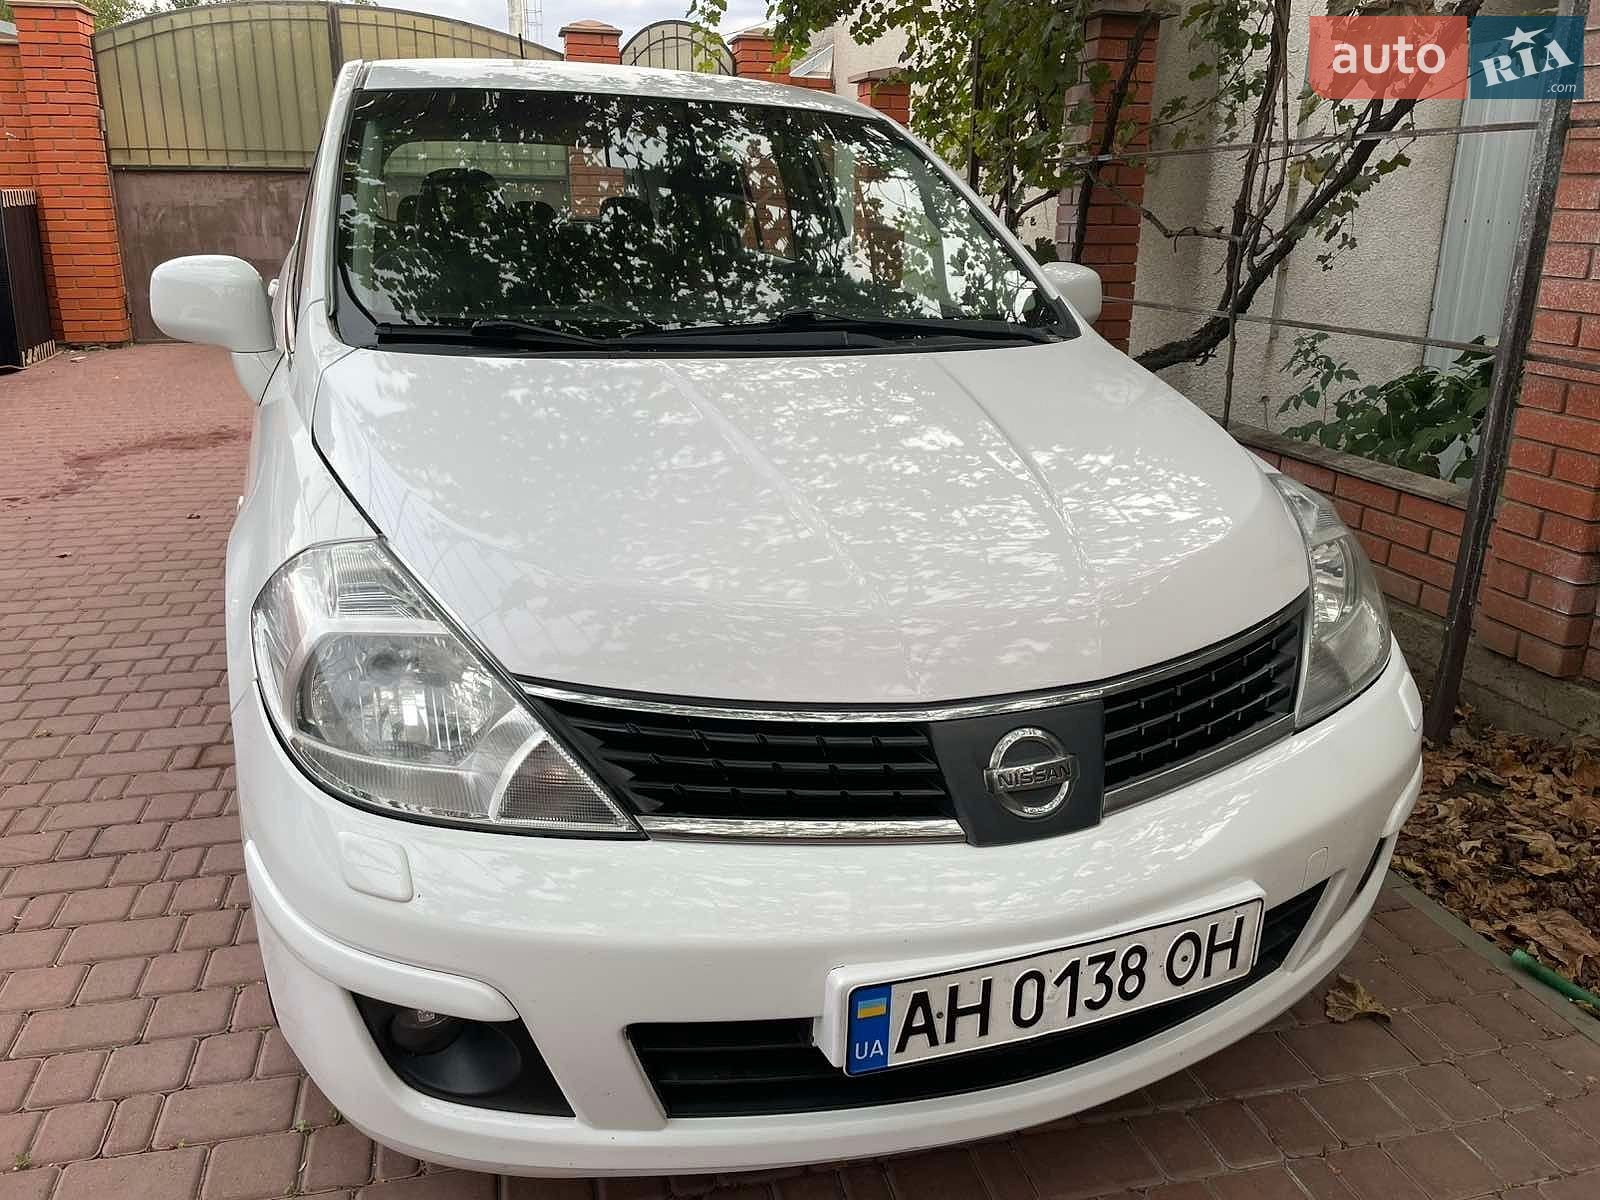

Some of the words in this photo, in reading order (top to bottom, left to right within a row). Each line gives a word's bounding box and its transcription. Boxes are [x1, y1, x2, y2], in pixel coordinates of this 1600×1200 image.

[997, 760, 1072, 788] NISSAN
[894, 976, 992, 1054] AH
[1011, 944, 1148, 1029] 0138
[1165, 914, 1245, 987] OH
[854, 1038, 884, 1061] UA
